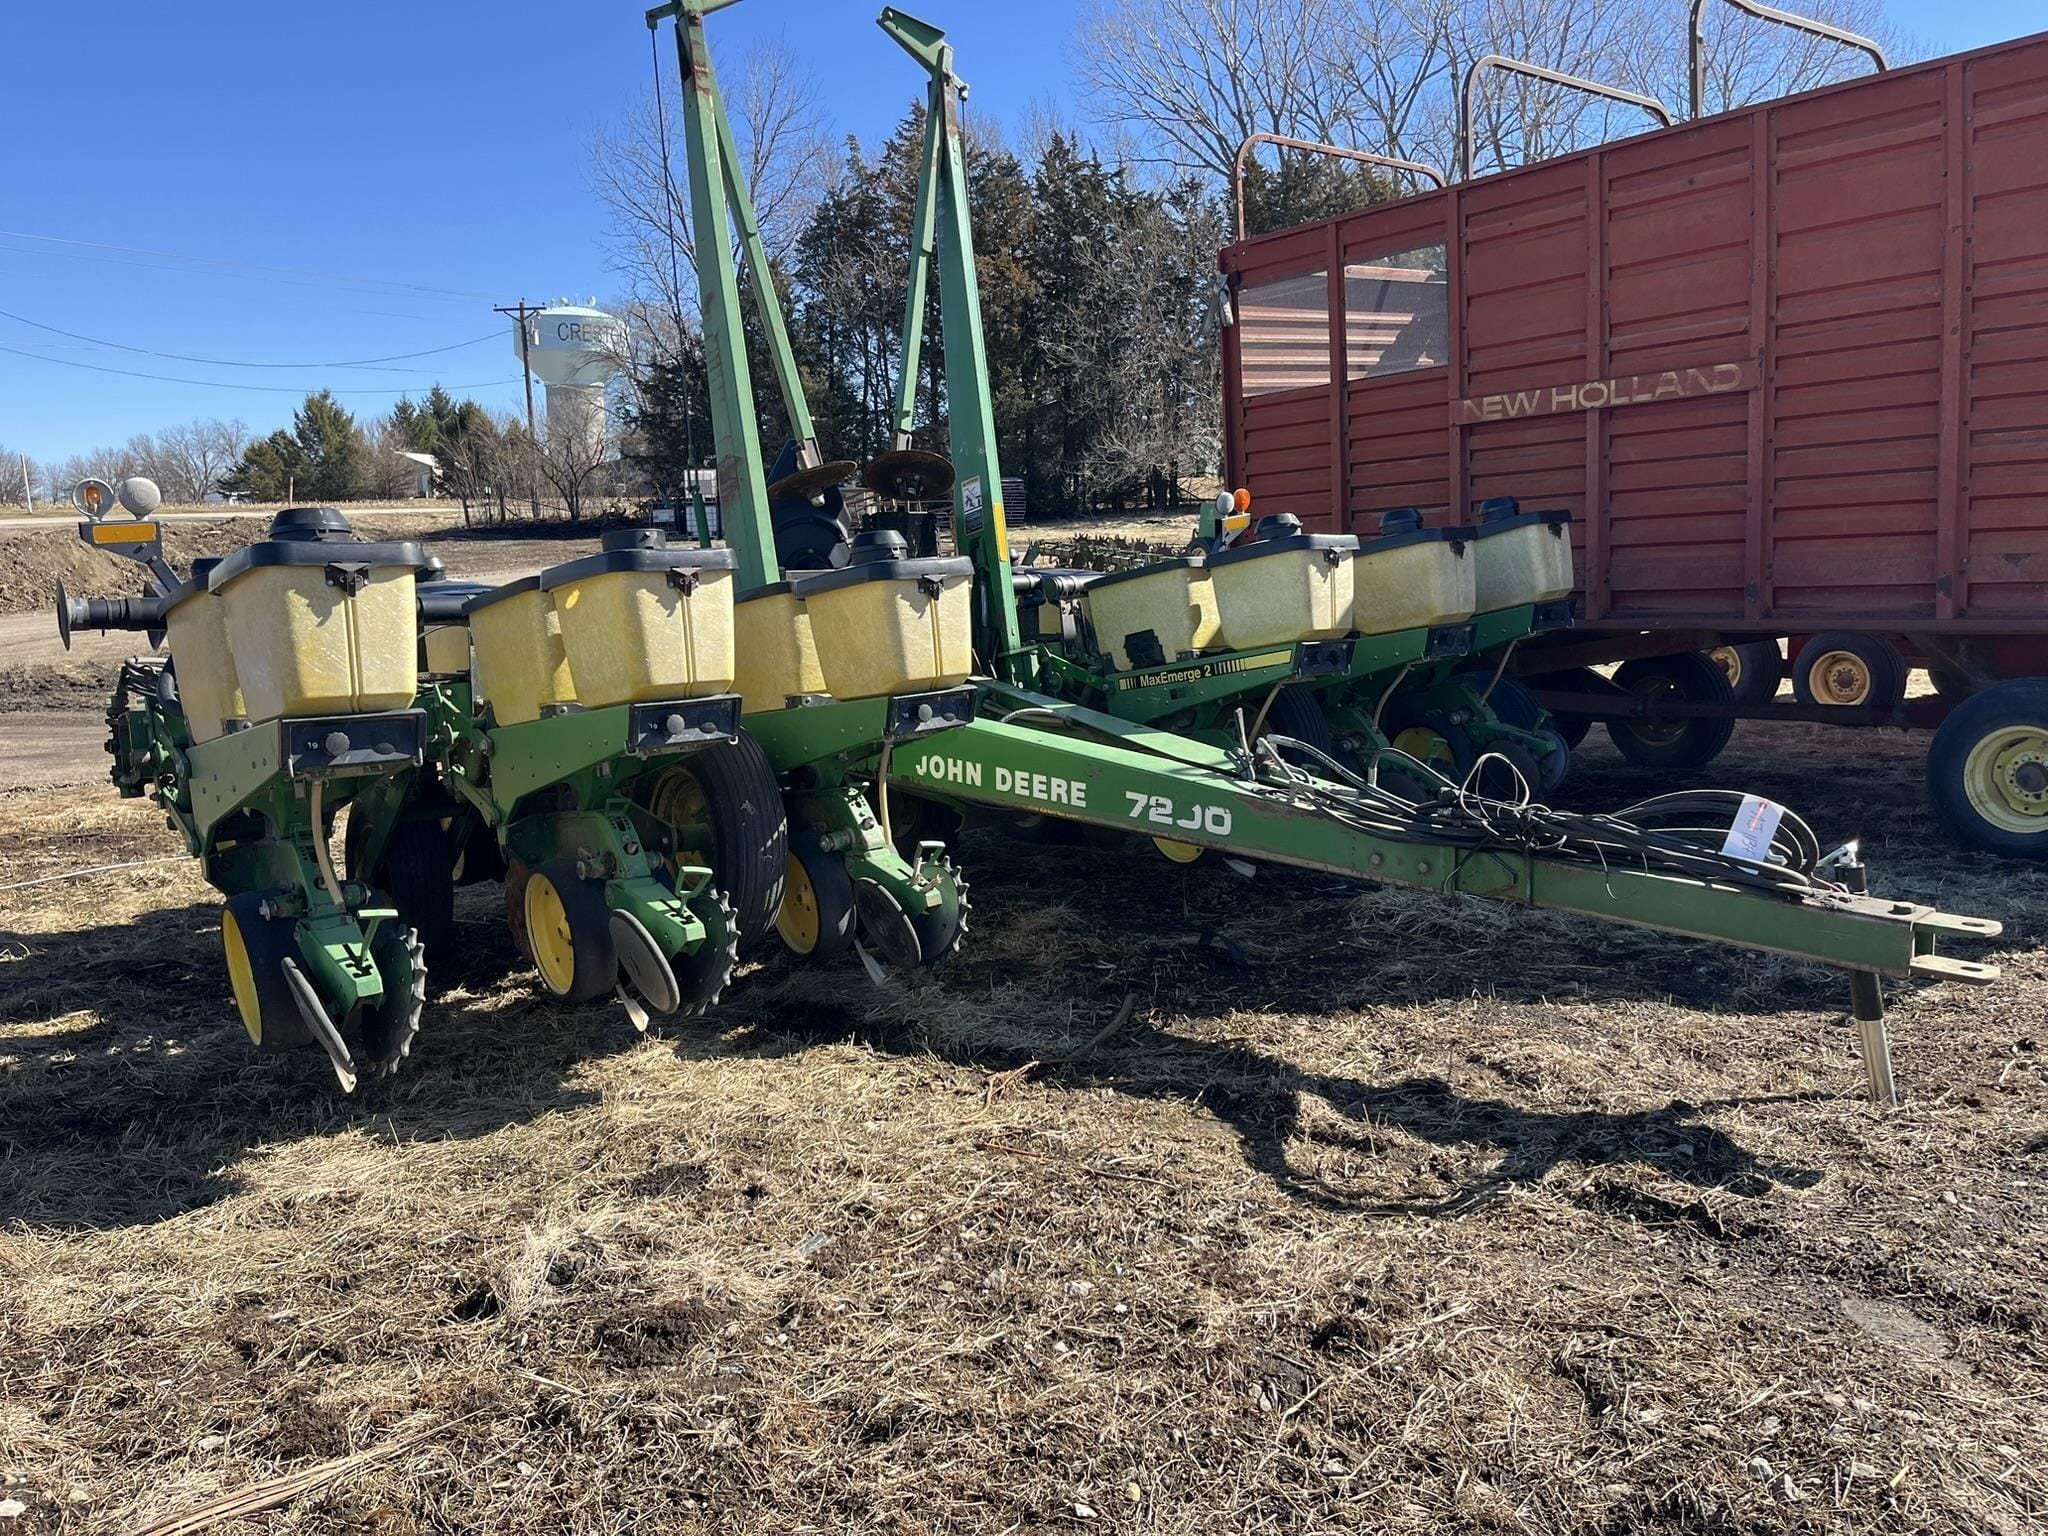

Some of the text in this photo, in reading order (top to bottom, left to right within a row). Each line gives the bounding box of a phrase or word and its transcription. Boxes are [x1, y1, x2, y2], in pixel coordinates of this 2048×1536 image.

[1463, 363, 1743, 421] NEW HOLLAND
[1140, 664, 1212, 687] MaxEmerge 2
[915, 754, 982, 787] JOHN
[995, 766, 1087, 808] DEERE
